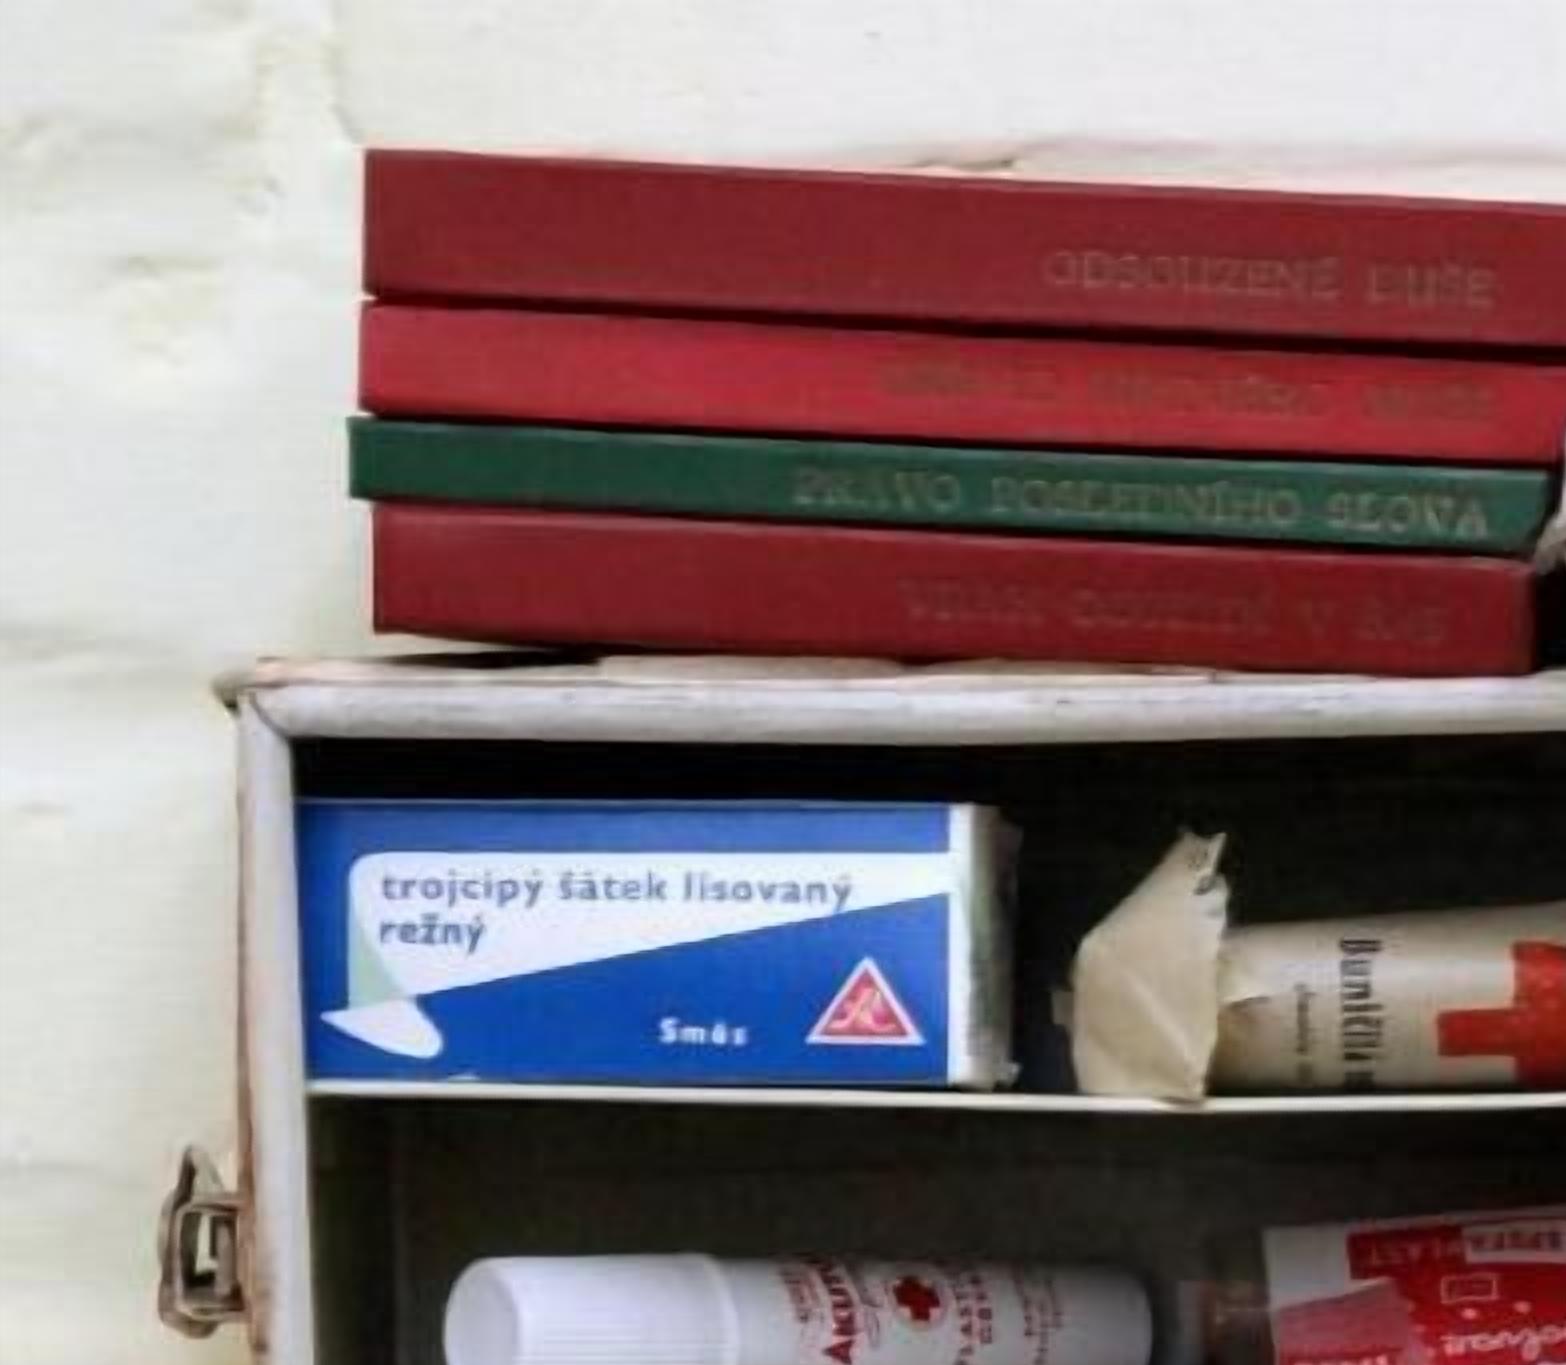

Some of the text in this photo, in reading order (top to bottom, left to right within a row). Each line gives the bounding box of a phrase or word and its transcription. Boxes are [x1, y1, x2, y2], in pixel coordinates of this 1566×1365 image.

[558, 866, 667, 903] šátek
[682, 868, 853, 912] lisovaný
[378, 917, 487, 955] režný
